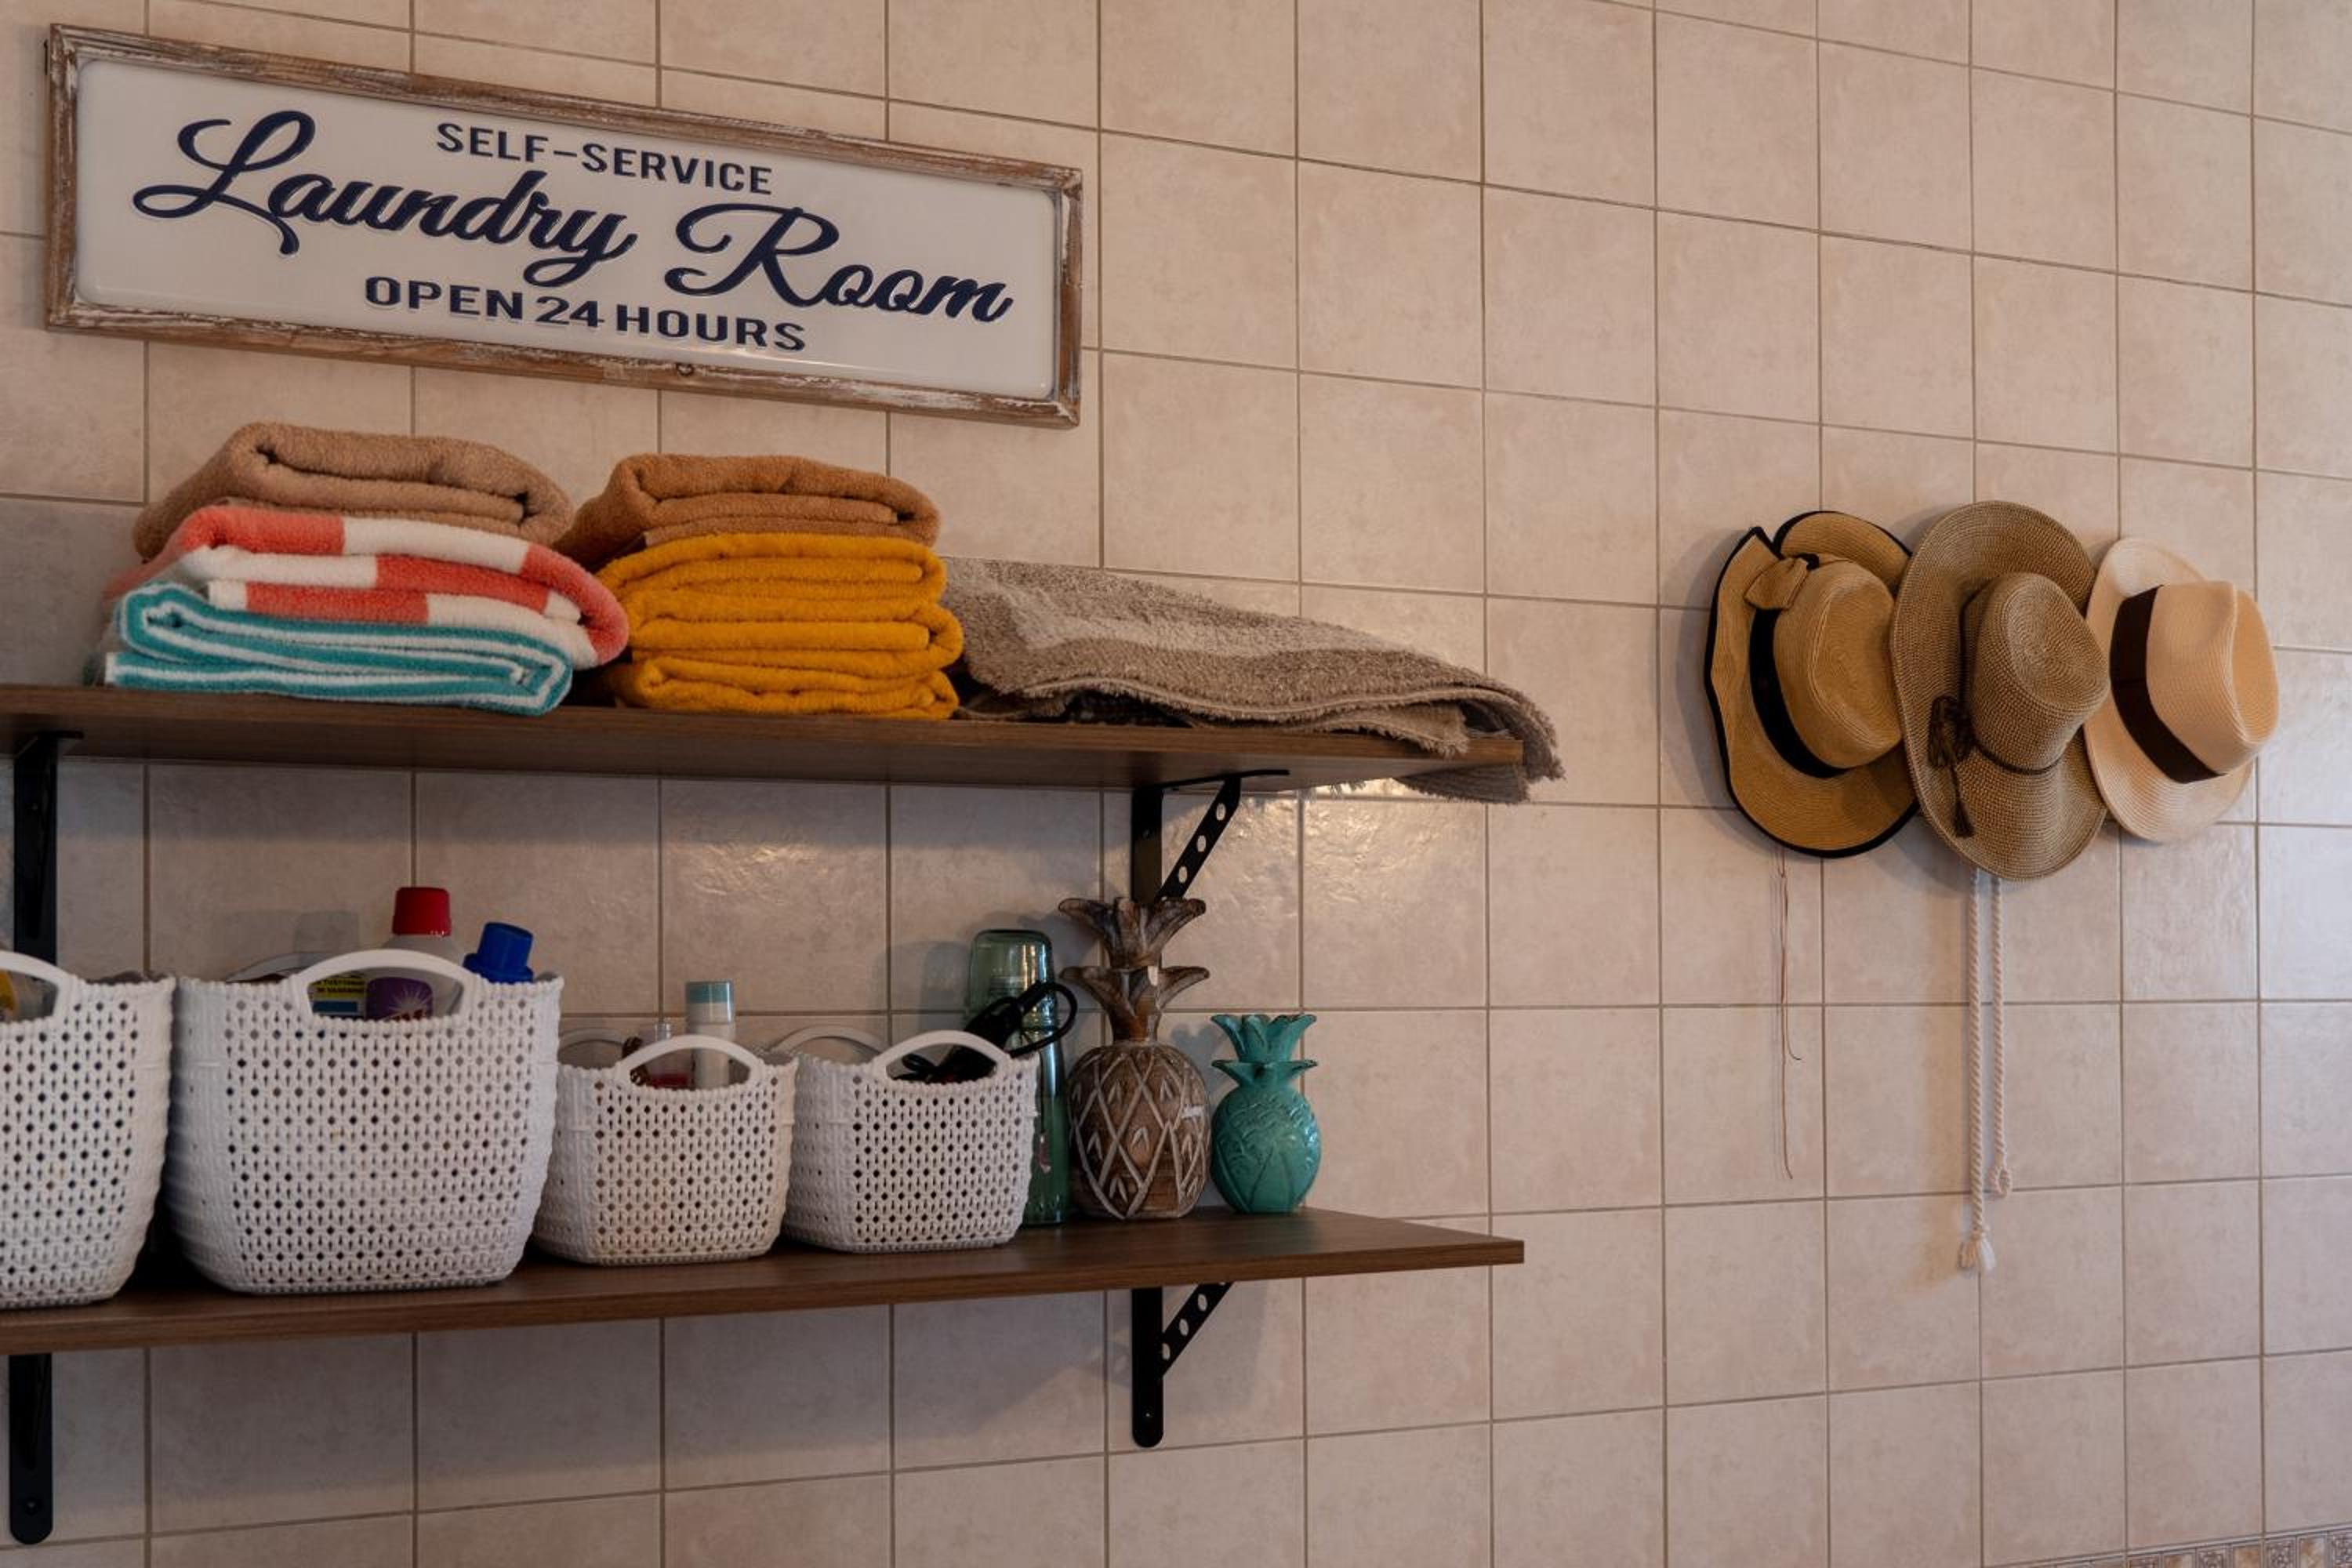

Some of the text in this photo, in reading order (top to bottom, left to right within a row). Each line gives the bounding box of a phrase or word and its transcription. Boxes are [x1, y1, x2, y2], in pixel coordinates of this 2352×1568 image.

[437, 122, 772, 195] SELF-SERVICE
[132, 110, 1014, 323] Laundry Room
[365, 276, 806, 352] OPEN 24 HOURS
